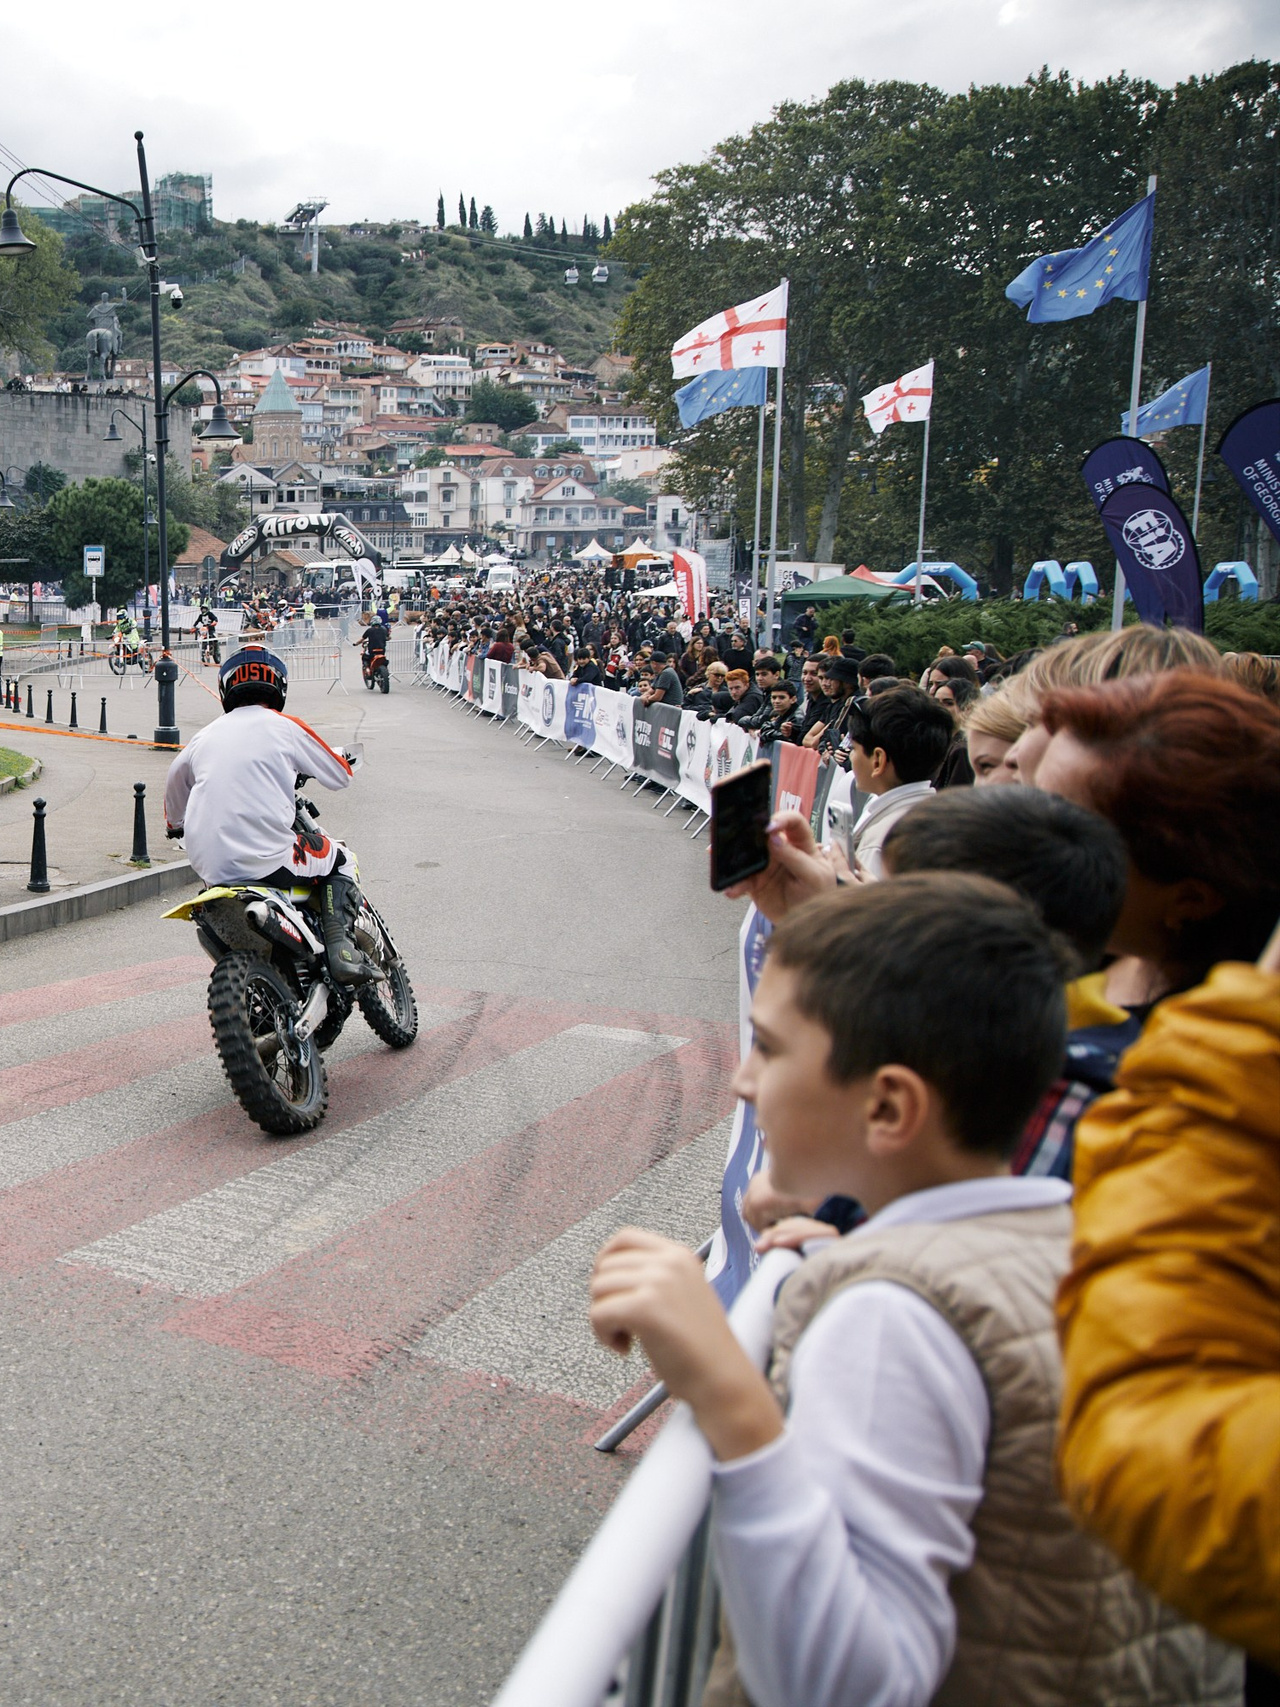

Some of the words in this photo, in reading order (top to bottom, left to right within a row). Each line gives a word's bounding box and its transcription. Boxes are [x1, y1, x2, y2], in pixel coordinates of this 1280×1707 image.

[1243, 466, 1259, 481] OF
[1094, 482, 1105, 496] OF
[231, 529, 256, 555] Airoh
[335, 529, 361, 555] Airoh
